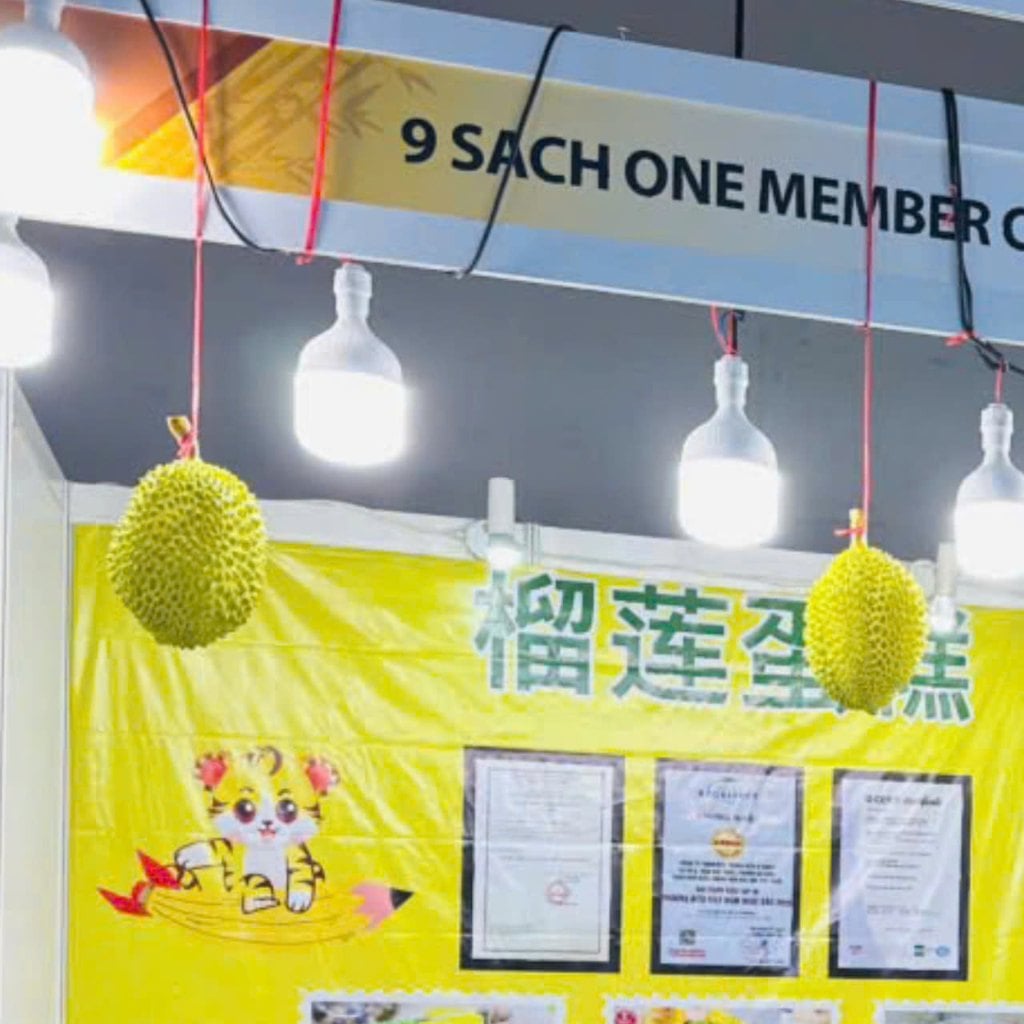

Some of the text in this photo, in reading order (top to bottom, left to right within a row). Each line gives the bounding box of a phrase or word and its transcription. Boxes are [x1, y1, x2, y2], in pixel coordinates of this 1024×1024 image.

[400, 118, 438, 164] 9
[451, 123, 610, 191] SACH
[624, 149, 746, 211] ONE
[758, 168, 991, 246] MEMBER
[474, 573, 972, 721] 榴莲蛋
